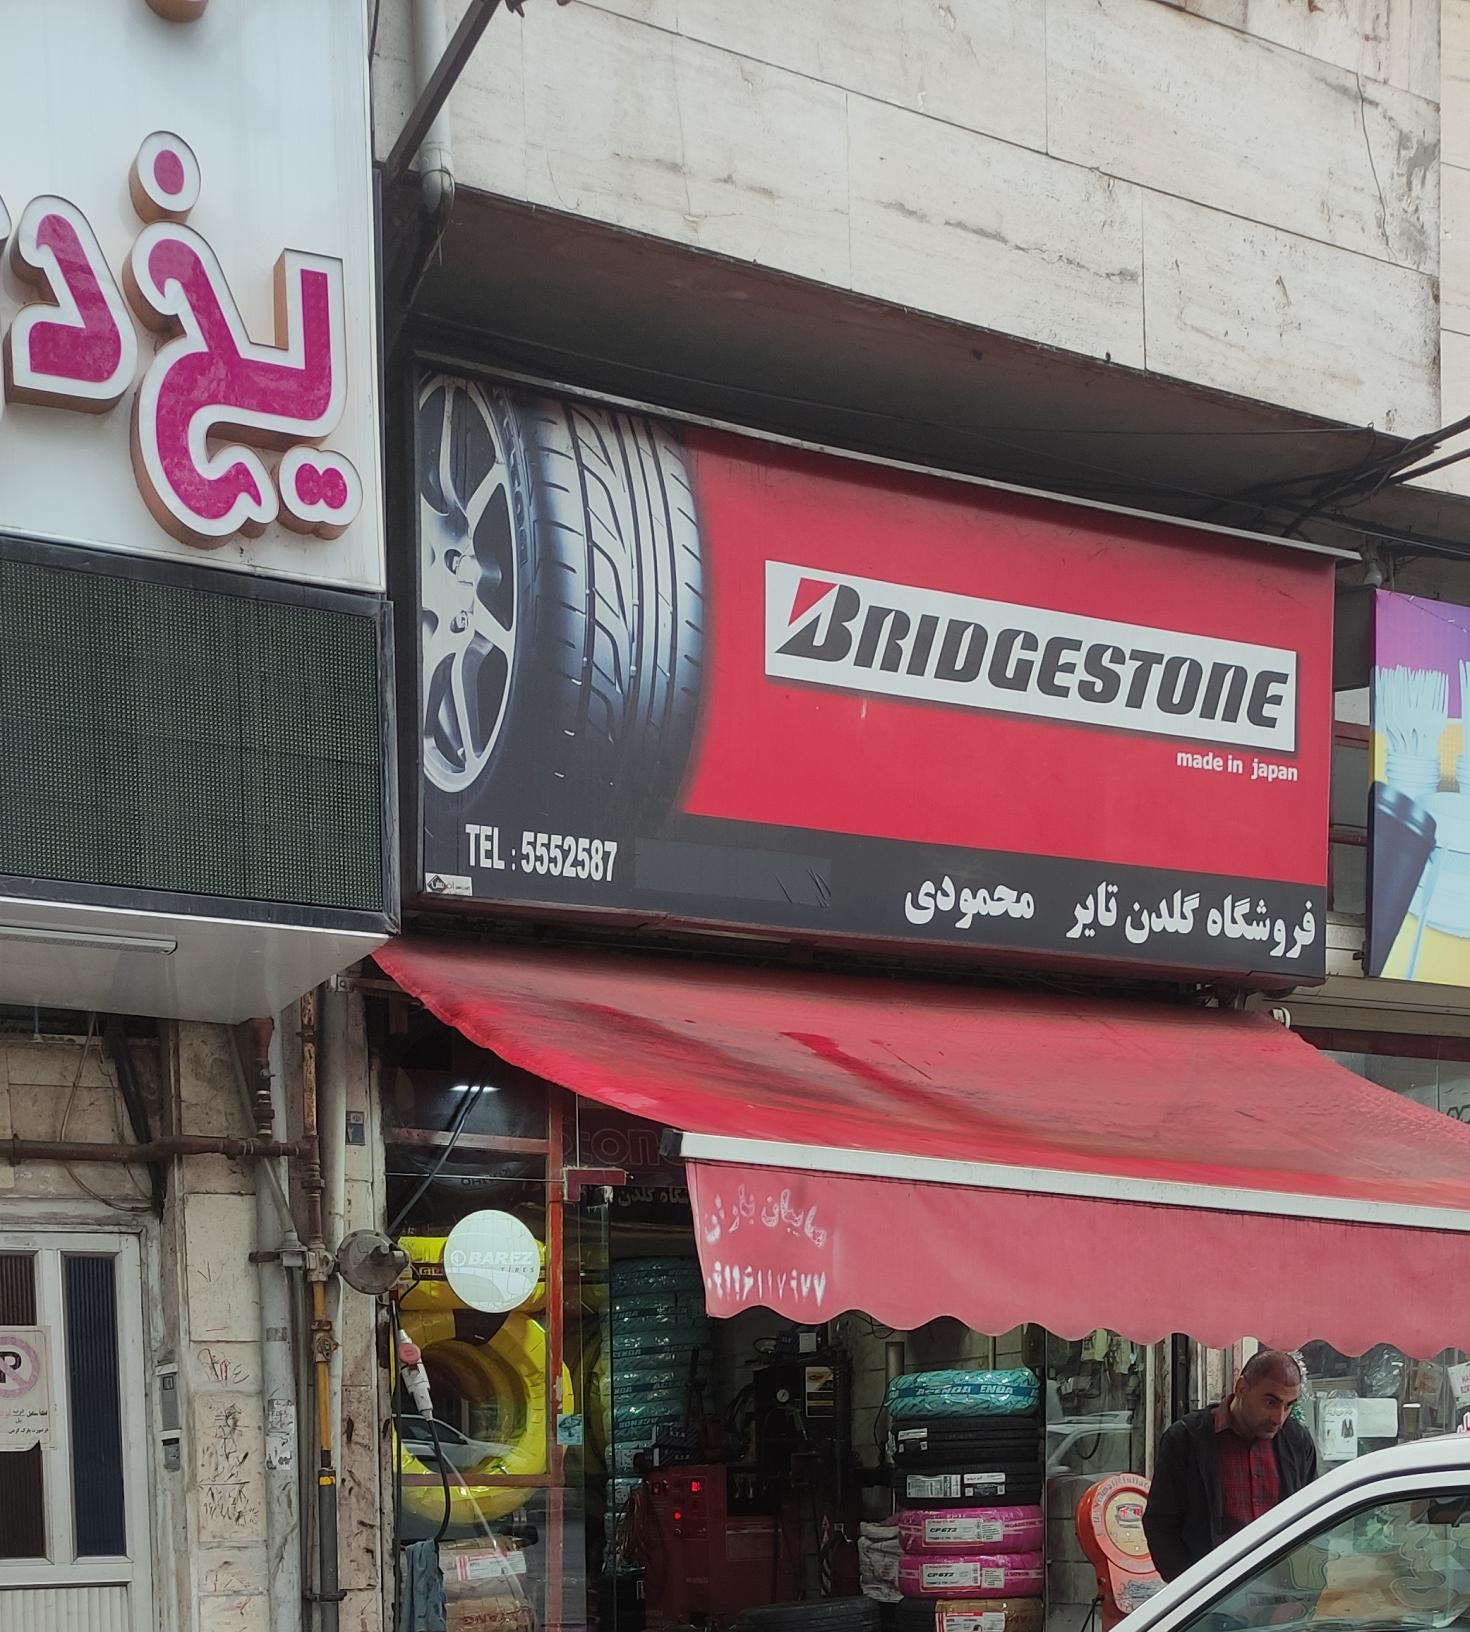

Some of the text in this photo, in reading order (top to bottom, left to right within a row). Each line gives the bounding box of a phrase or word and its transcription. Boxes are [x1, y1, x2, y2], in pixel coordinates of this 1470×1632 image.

[0, 131, 363, 548] یخد
[774, 577, 1289, 729] BRIDGESTONE
[1176, 752, 1298, 782] made in japan
[465, 824, 505, 870] TEL
[521, 831, 618, 881] 5552587
[905, 875, 1316, 958] فروشگاه گلدن تایر محمودی
